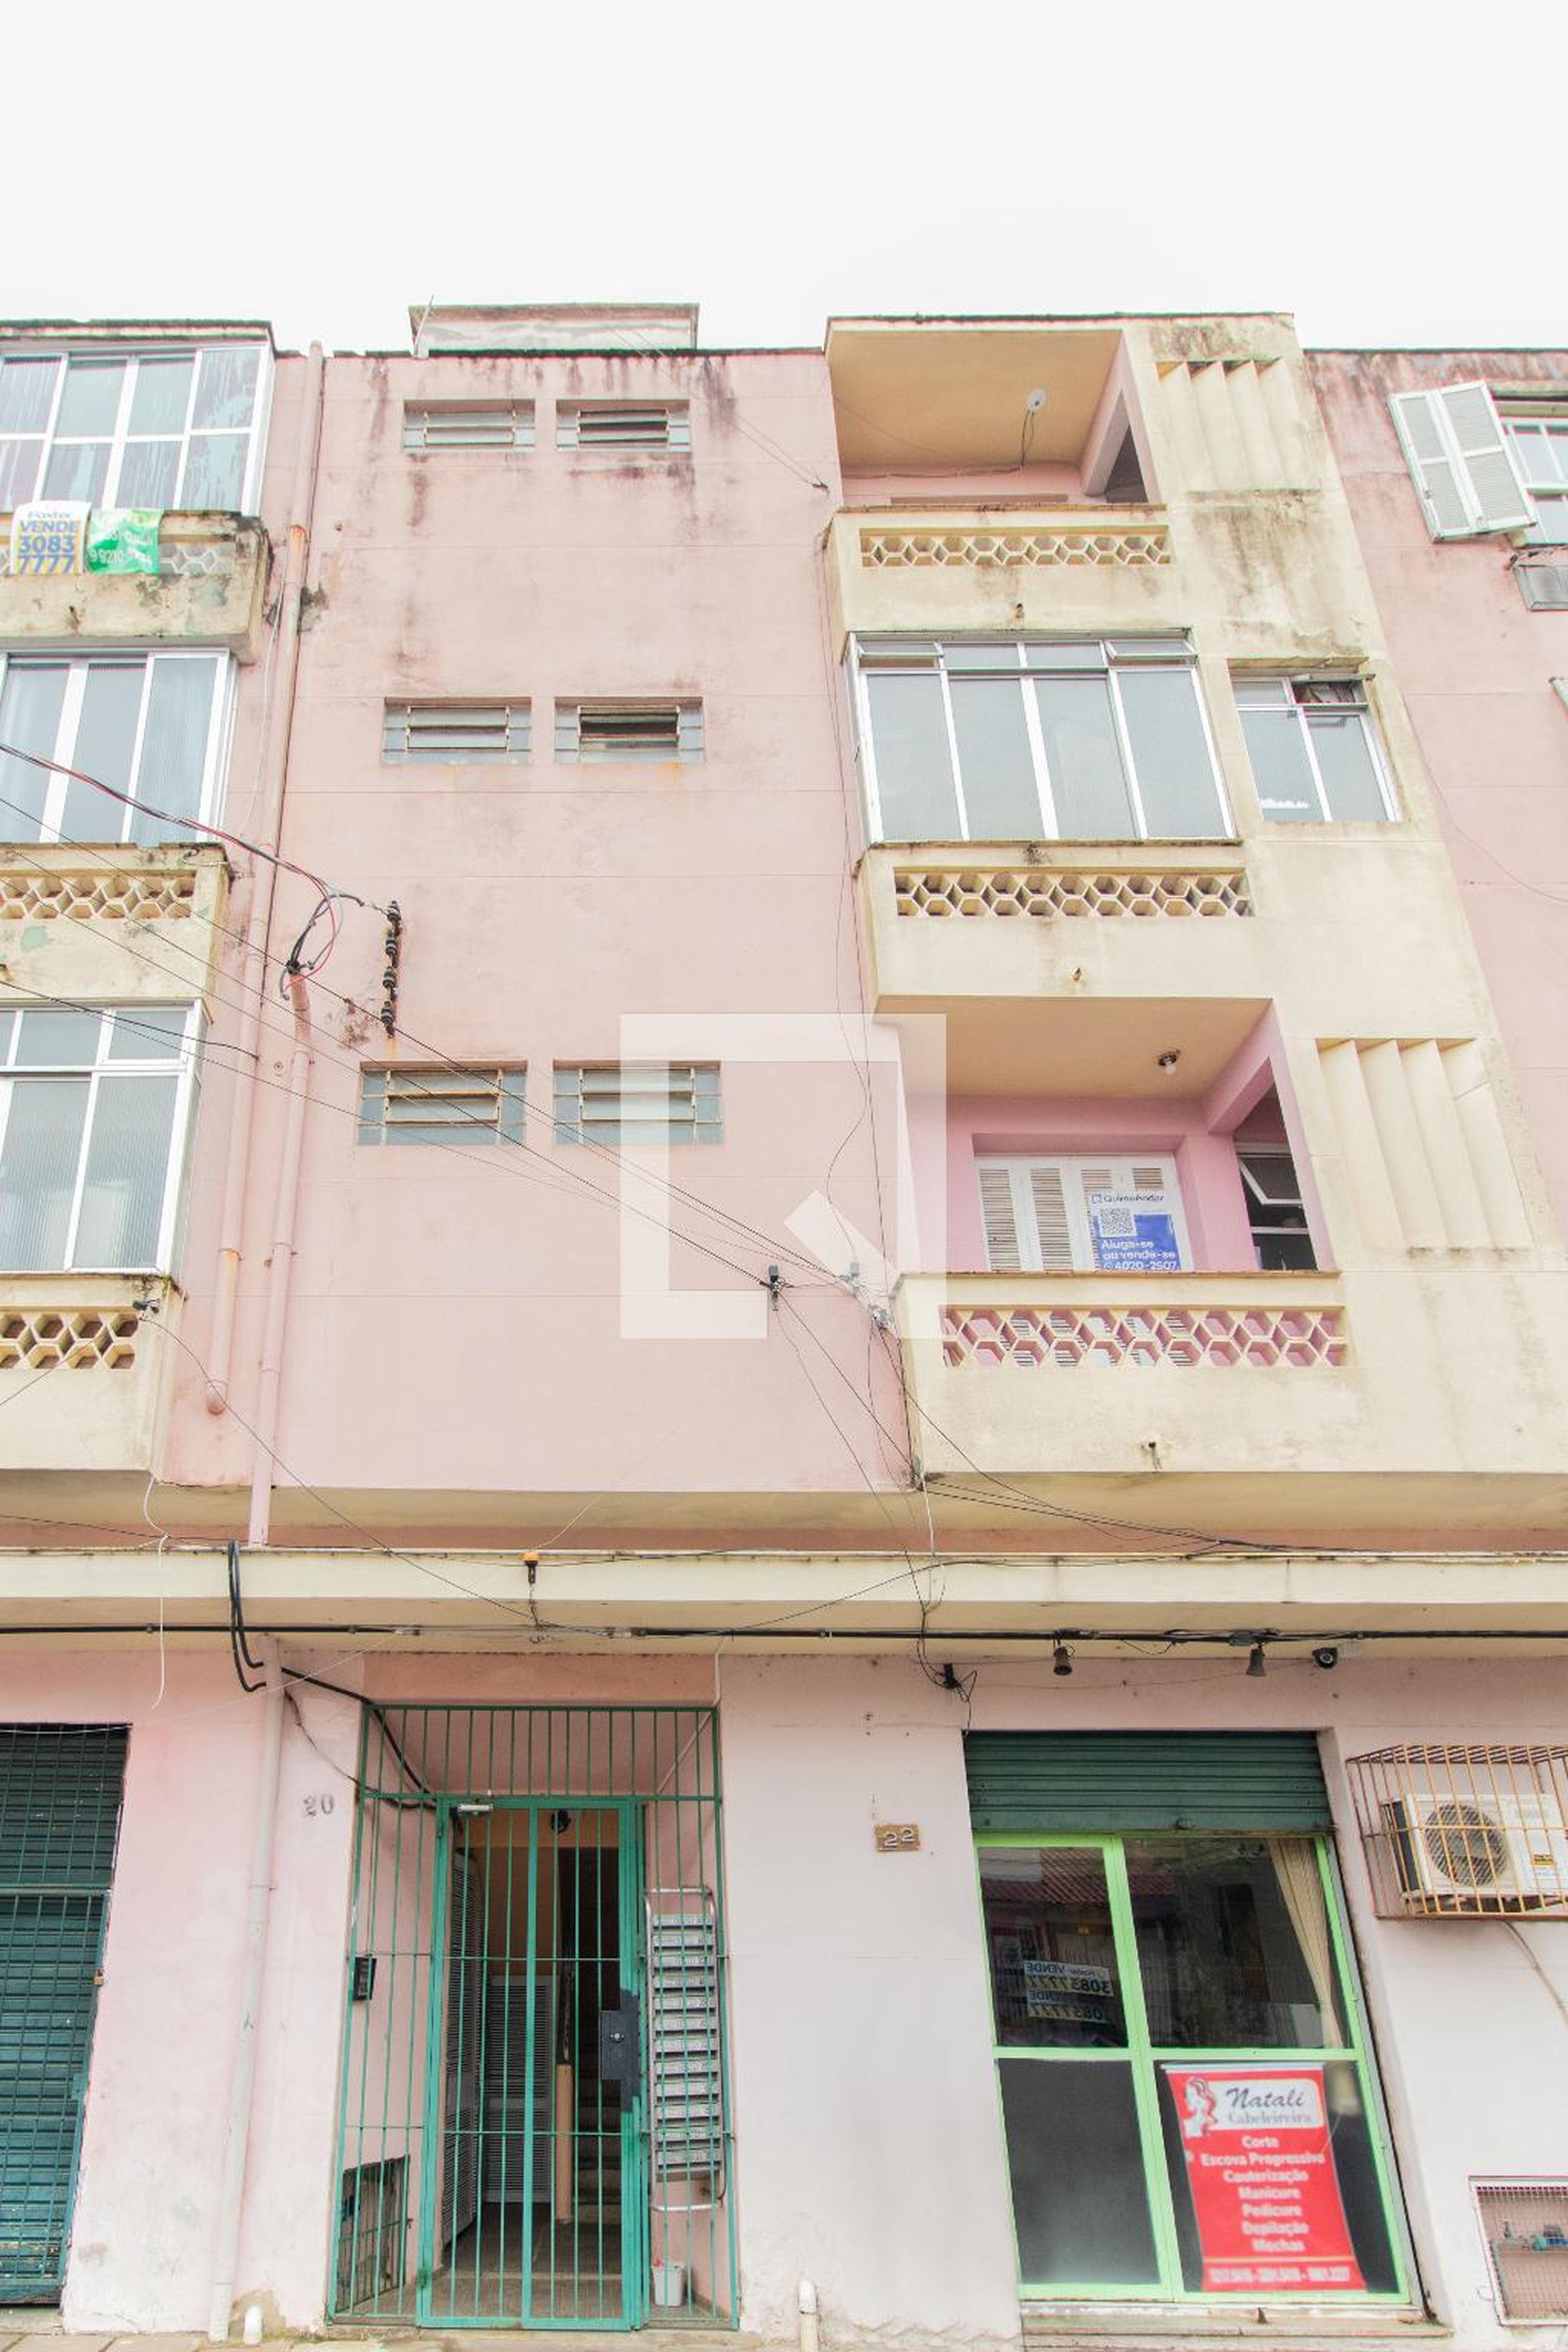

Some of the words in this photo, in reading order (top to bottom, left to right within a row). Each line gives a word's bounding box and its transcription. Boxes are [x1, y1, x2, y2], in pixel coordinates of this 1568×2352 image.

[20, 520, 76, 532] VENDE
[19, 535, 75, 552] 3083
[18, 555, 75, 574] 7777
[1102, 1240, 1154, 1250] Aluga-se
[1103, 1252, 1118, 1260] ou
[1120, 1249, 1176, 1260] vende-se
[1115, 1261, 1177, 1270] 4020-2507
[303, 1794, 334, 1816] 20
[884, 1828, 915, 1846] 22
[1225, 2087, 1305, 2109] Natali
[1200, 2153, 1247, 2166] Escova
[1249, 2151, 1325, 2167] Progressiva
